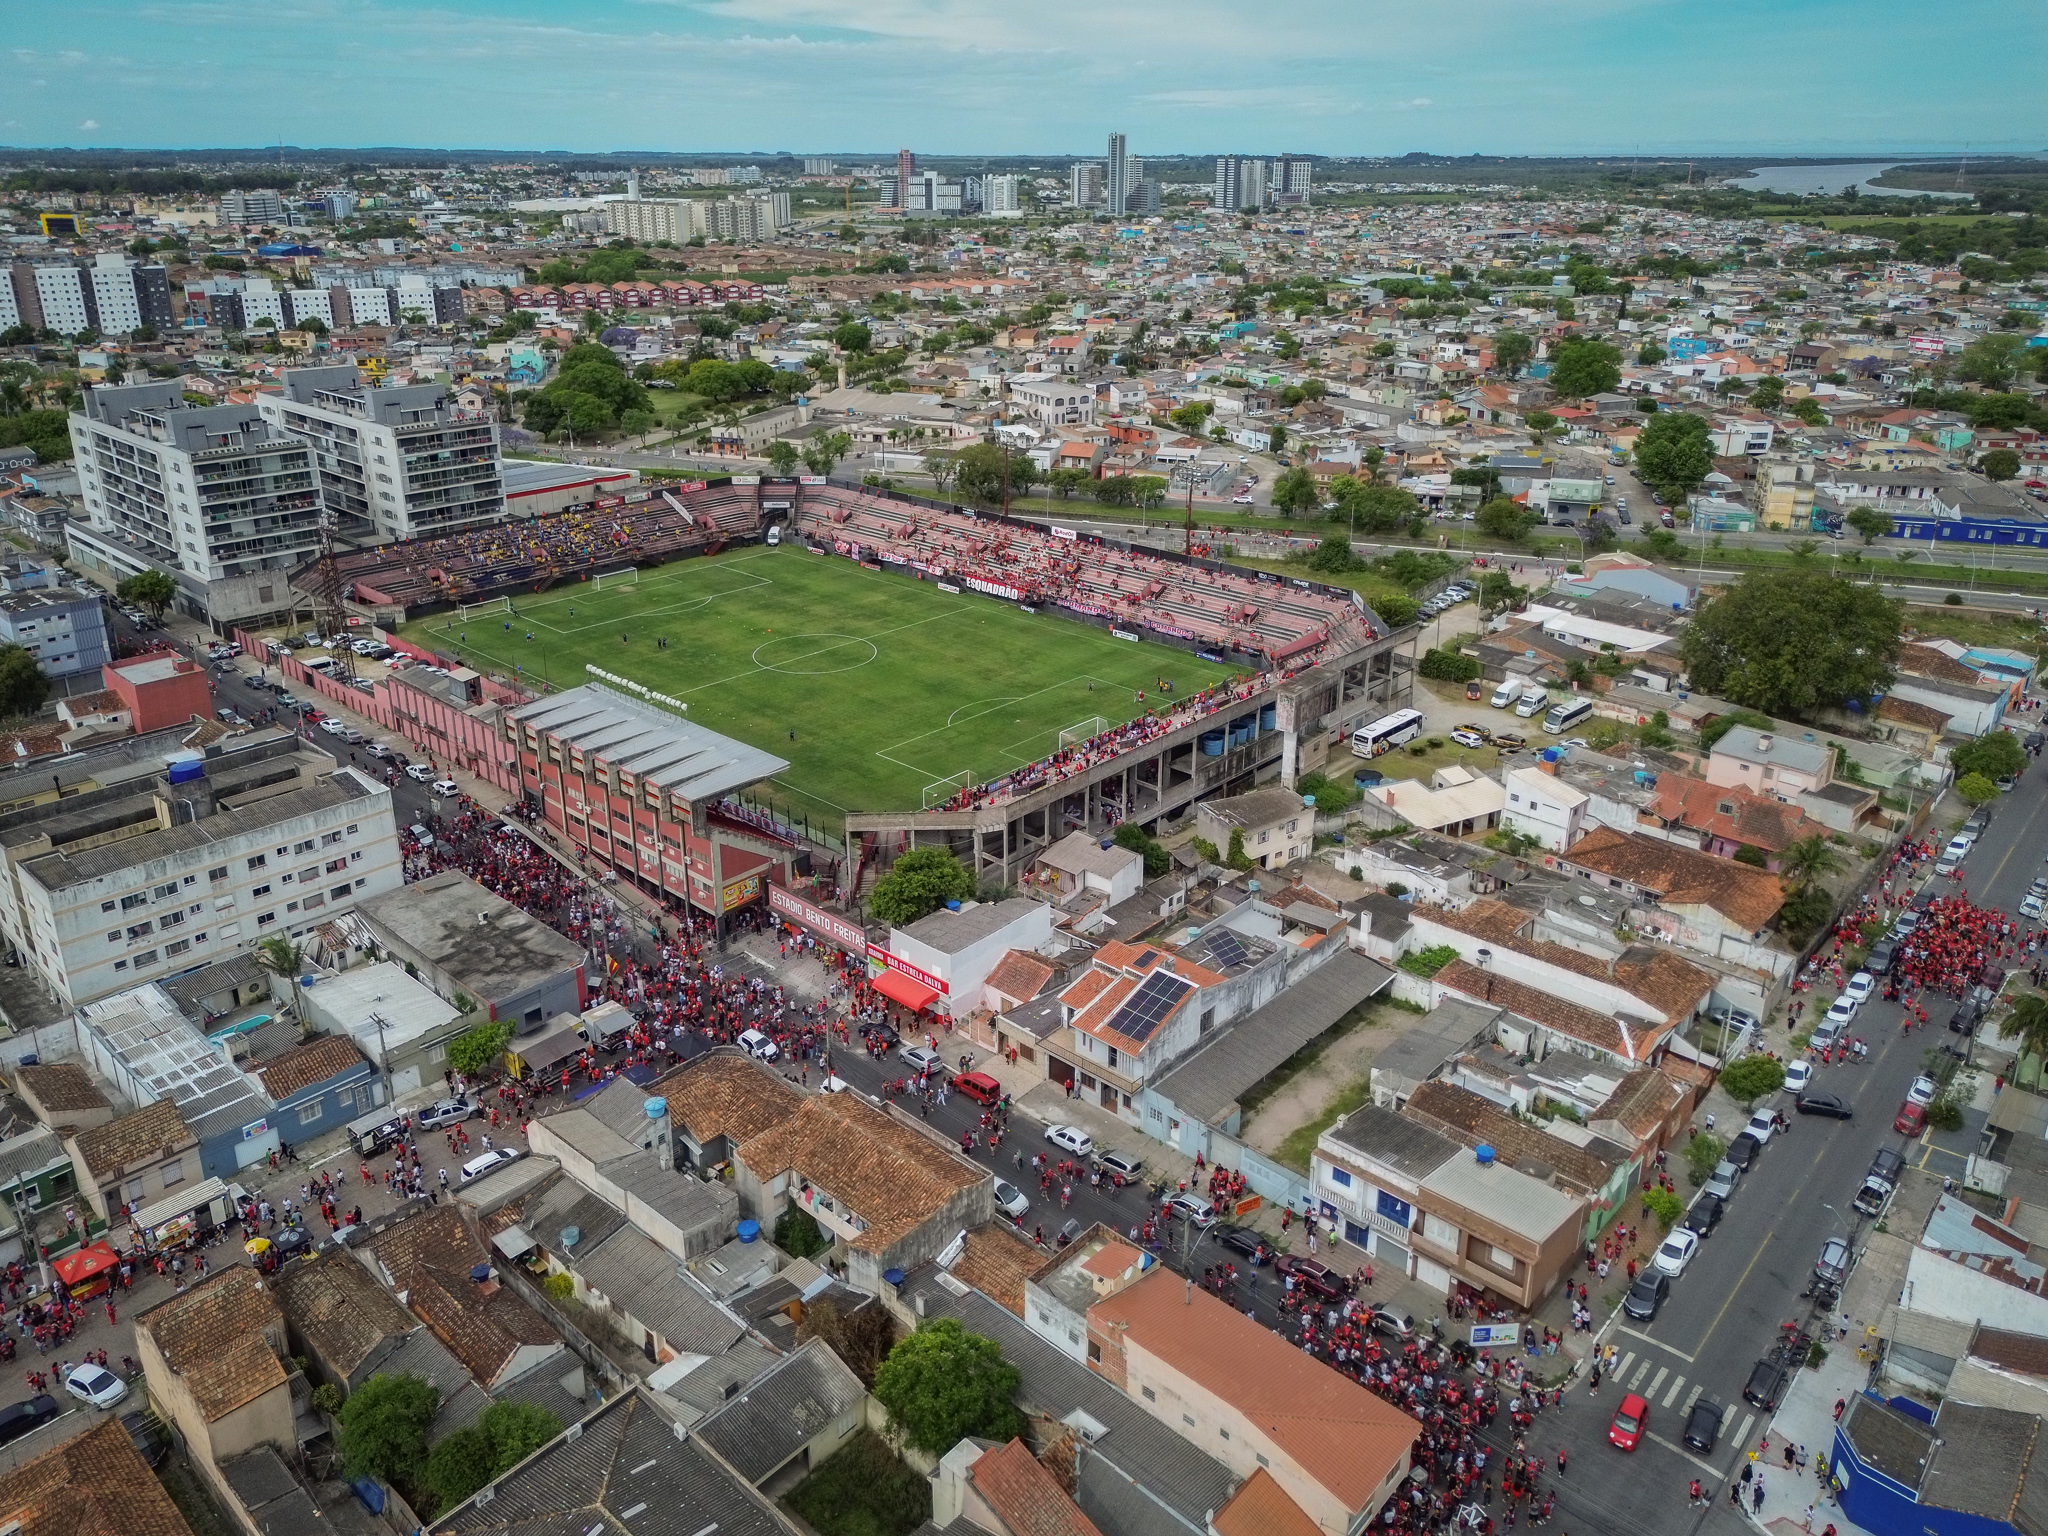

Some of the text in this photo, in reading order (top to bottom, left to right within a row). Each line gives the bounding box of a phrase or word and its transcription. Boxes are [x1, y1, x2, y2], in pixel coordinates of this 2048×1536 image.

[966, 577, 1018, 600] ESQUADRÃO
[772, 891, 866, 949] ESTADIO BENTO FREITAS
[887, 956, 899, 968] BAR
[900, 962, 923, 980] ESTRELA
